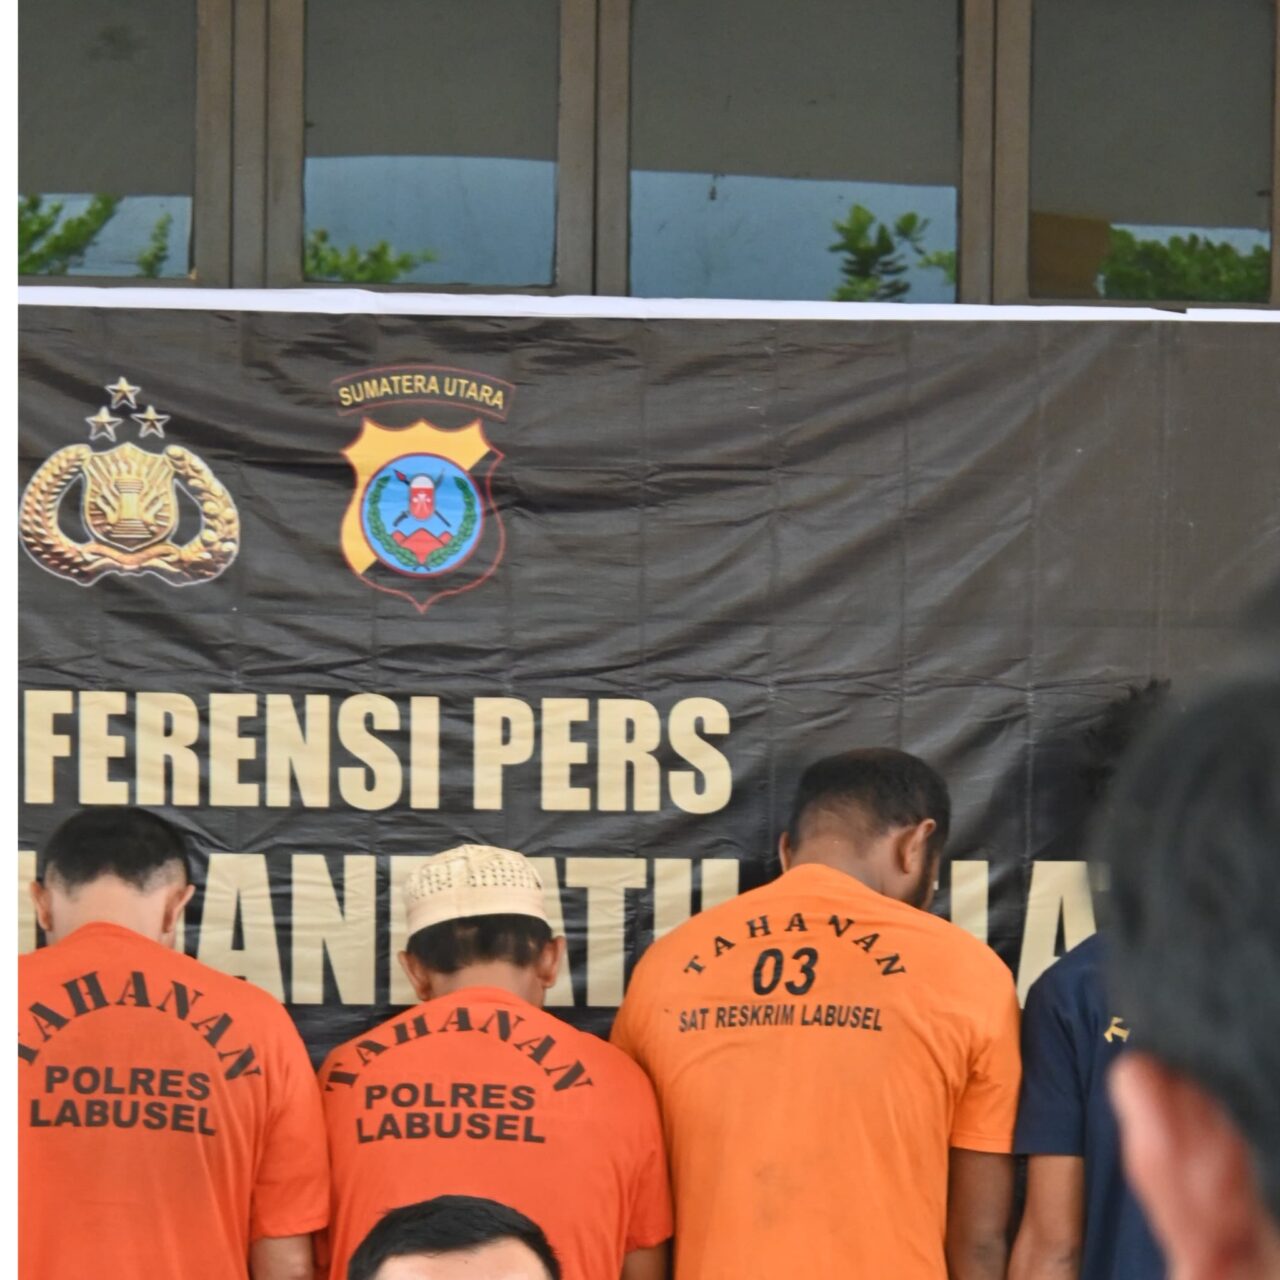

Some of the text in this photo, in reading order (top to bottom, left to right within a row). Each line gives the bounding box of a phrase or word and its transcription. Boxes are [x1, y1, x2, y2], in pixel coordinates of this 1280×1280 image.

[338, 374, 505, 410] SUMATERA UTARA
[473, 696, 732, 814] PERS
[683, 912, 907, 977] TAHANAN
[752, 946, 819, 996] 03
[679, 1004, 883, 1033] SAT RESKRIM LABUSEL
[325, 1006, 595, 1095] TAHANAN
[43, 1066, 211, 1101] POLRES
[364, 1082, 536, 1110] POLRES
[29, 1099, 217, 1136] LABUSEL
[356, 1111, 546, 1144] LABUSEL
